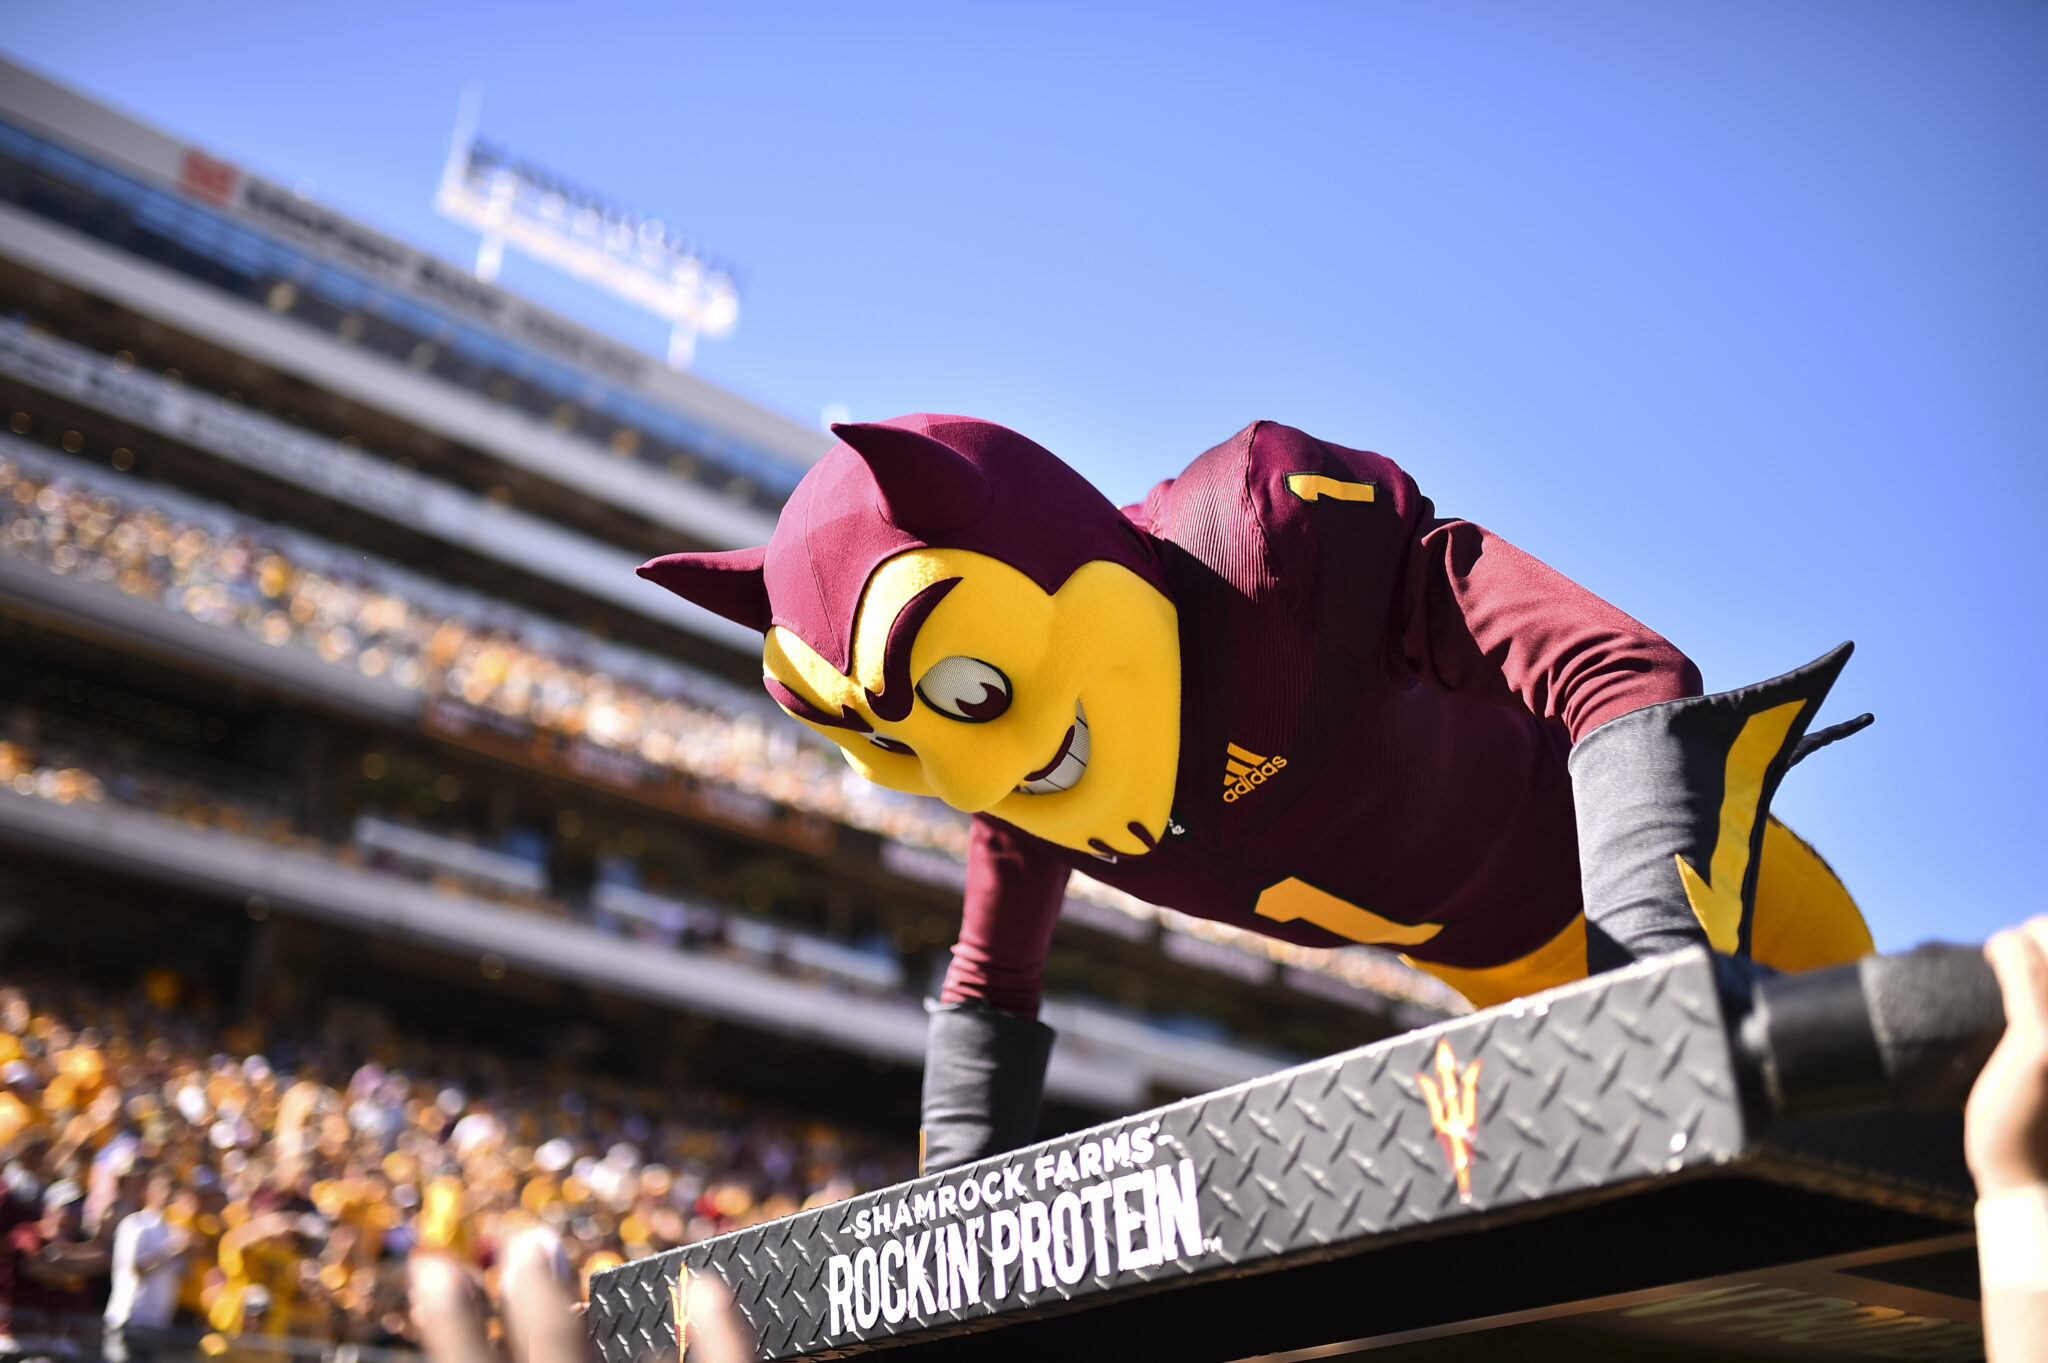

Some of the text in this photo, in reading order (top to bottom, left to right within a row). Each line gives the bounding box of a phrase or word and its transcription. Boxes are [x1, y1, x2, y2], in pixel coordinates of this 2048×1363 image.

[1285, 473, 1376, 503] 1
[1223, 755, 1288, 803] adidas
[1253, 876, 1446, 947] 1
[828, 1215, 985, 1336] ROCKIN'
[990, 1157, 1204, 1300] PROTEIN
